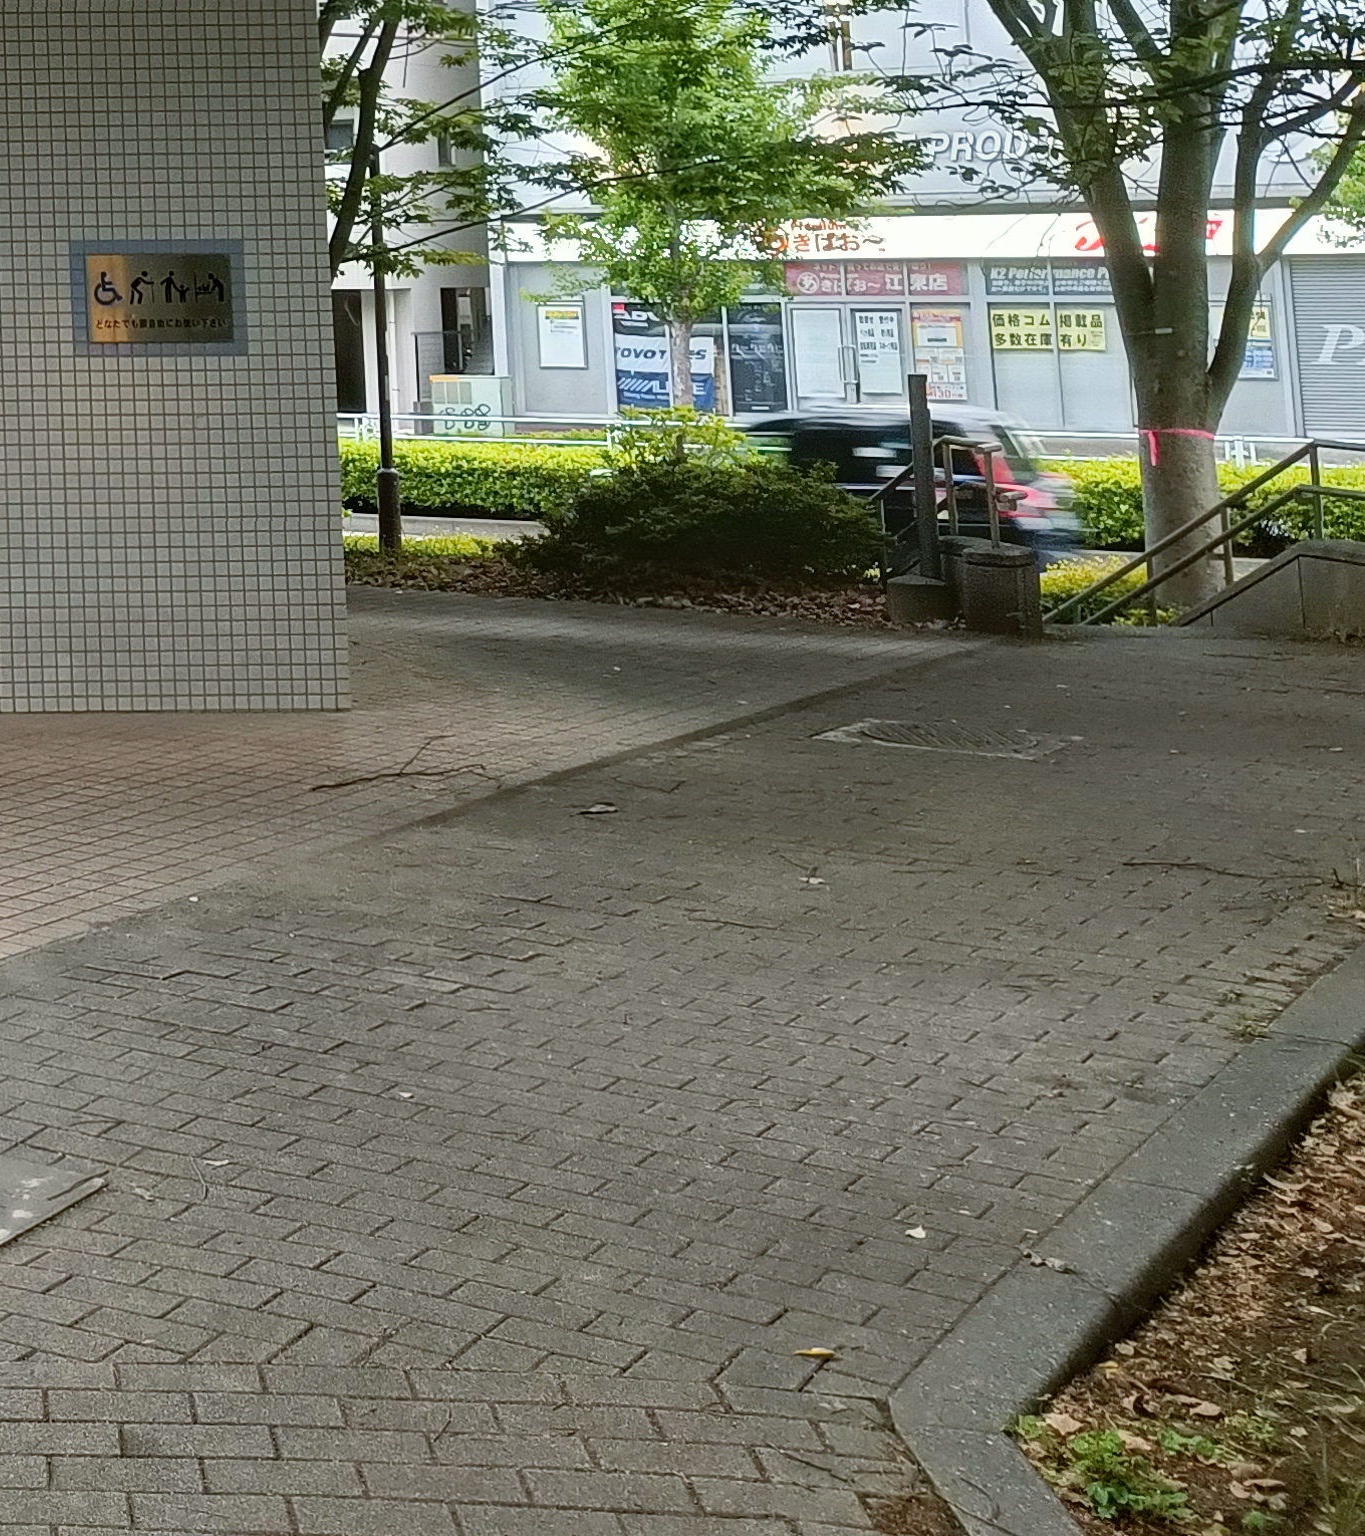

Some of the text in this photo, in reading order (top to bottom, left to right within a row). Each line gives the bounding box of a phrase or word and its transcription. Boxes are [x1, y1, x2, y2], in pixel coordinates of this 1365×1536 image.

[931, 130, 1028, 162] PROD
[614, 310, 660, 321] ADV
[1311, 324, 1365, 365] P
